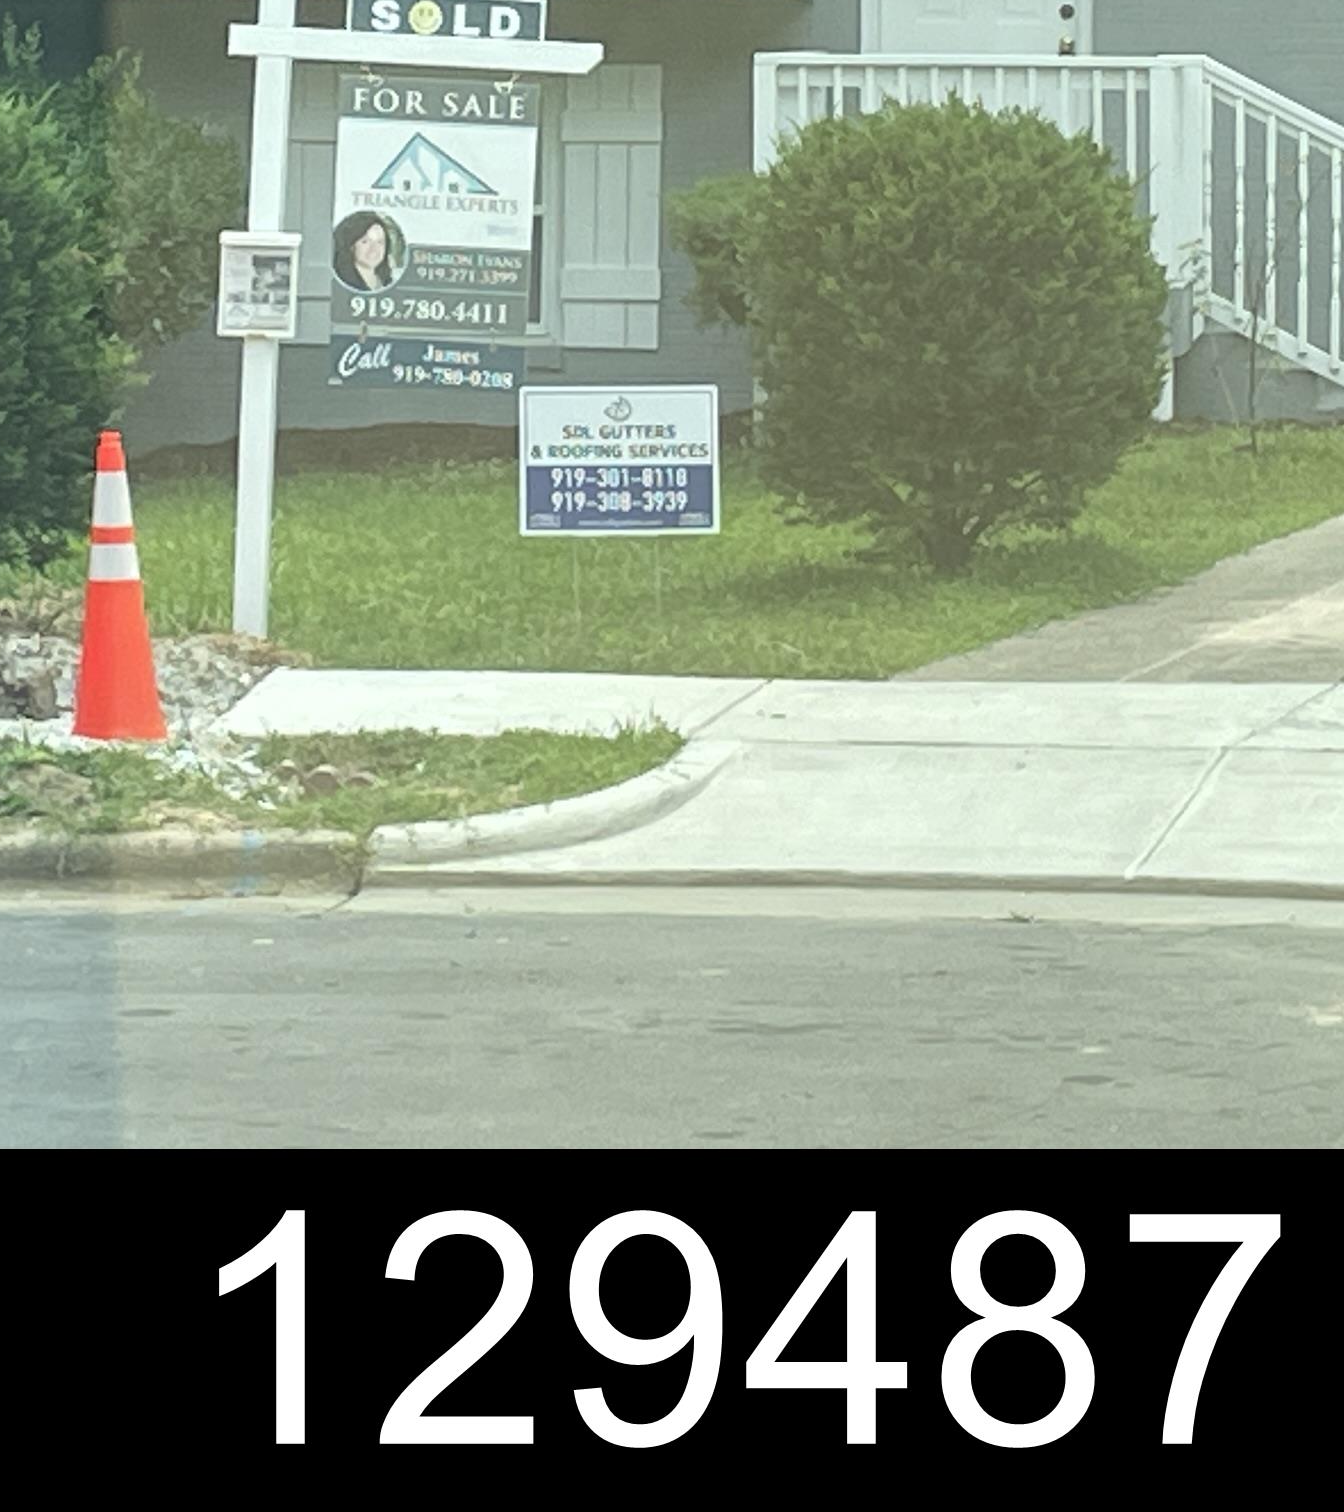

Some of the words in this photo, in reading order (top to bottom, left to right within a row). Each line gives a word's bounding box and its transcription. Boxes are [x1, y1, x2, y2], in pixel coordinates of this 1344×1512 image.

[353, 88, 428, 115] FOR
[441, 91, 526, 120] SALE
[352, 191, 440, 210] TRIANGLE
[446, 197, 519, 215] EXPERTS
[350, 296, 507, 324] 919.780.4411
[338, 343, 392, 377] Call
[421, 344, 480, 365] James
[599, 424, 677, 440] GUTTERS
[548, 445, 622, 459] ROOFING
[628, 443, 709, 459] SERVICES
